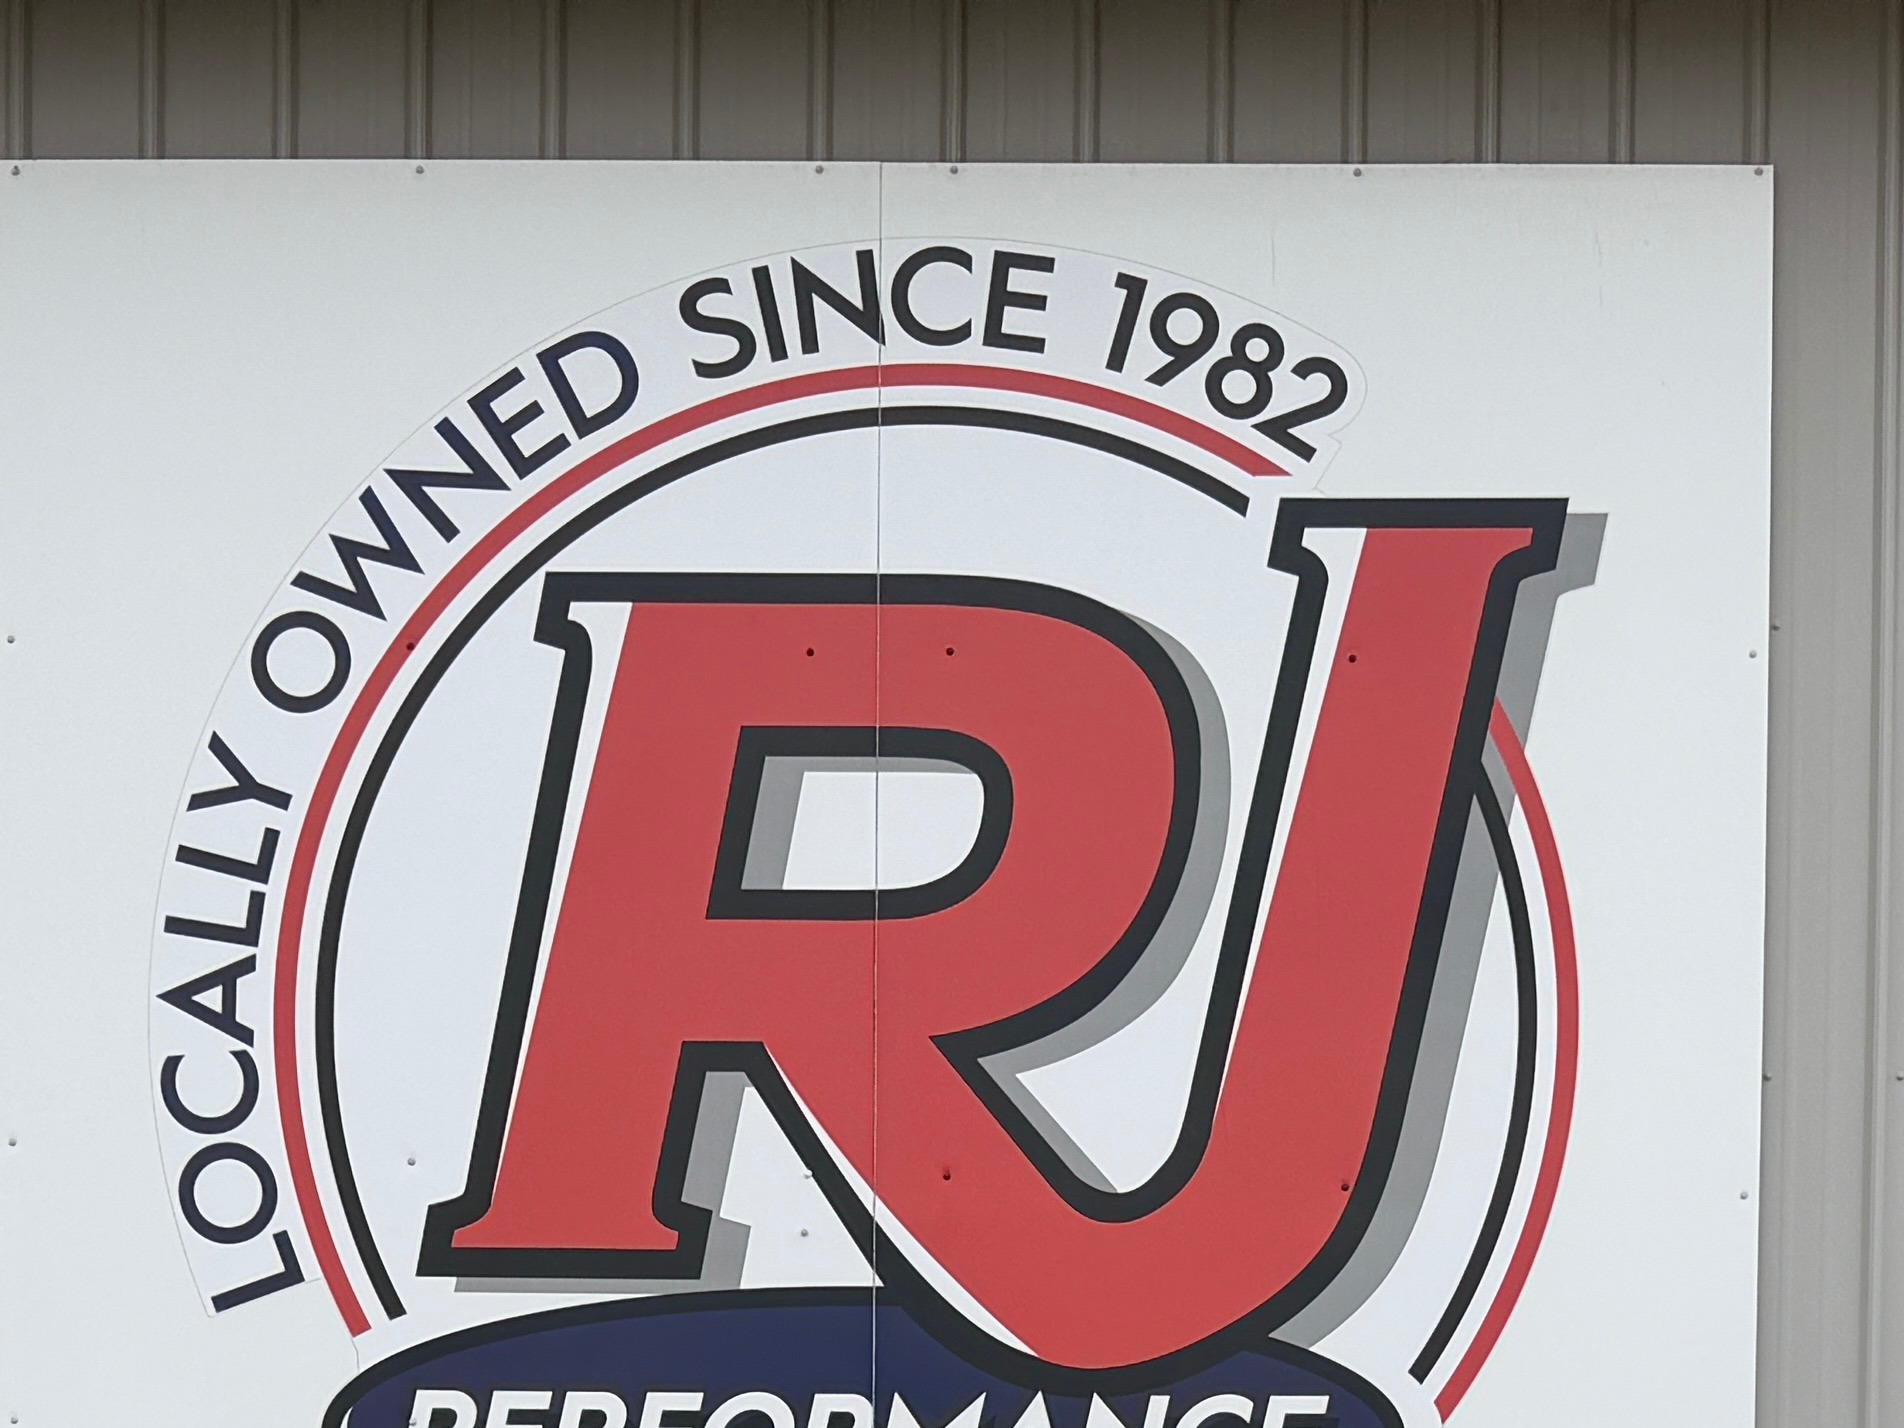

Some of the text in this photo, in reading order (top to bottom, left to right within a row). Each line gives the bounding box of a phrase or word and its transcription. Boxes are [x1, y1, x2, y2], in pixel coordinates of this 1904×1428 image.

[156, 246, 1348, 1313] LOCALLY OWNED SINCE 1982
[417, 498, 1569, 1393] RJ
